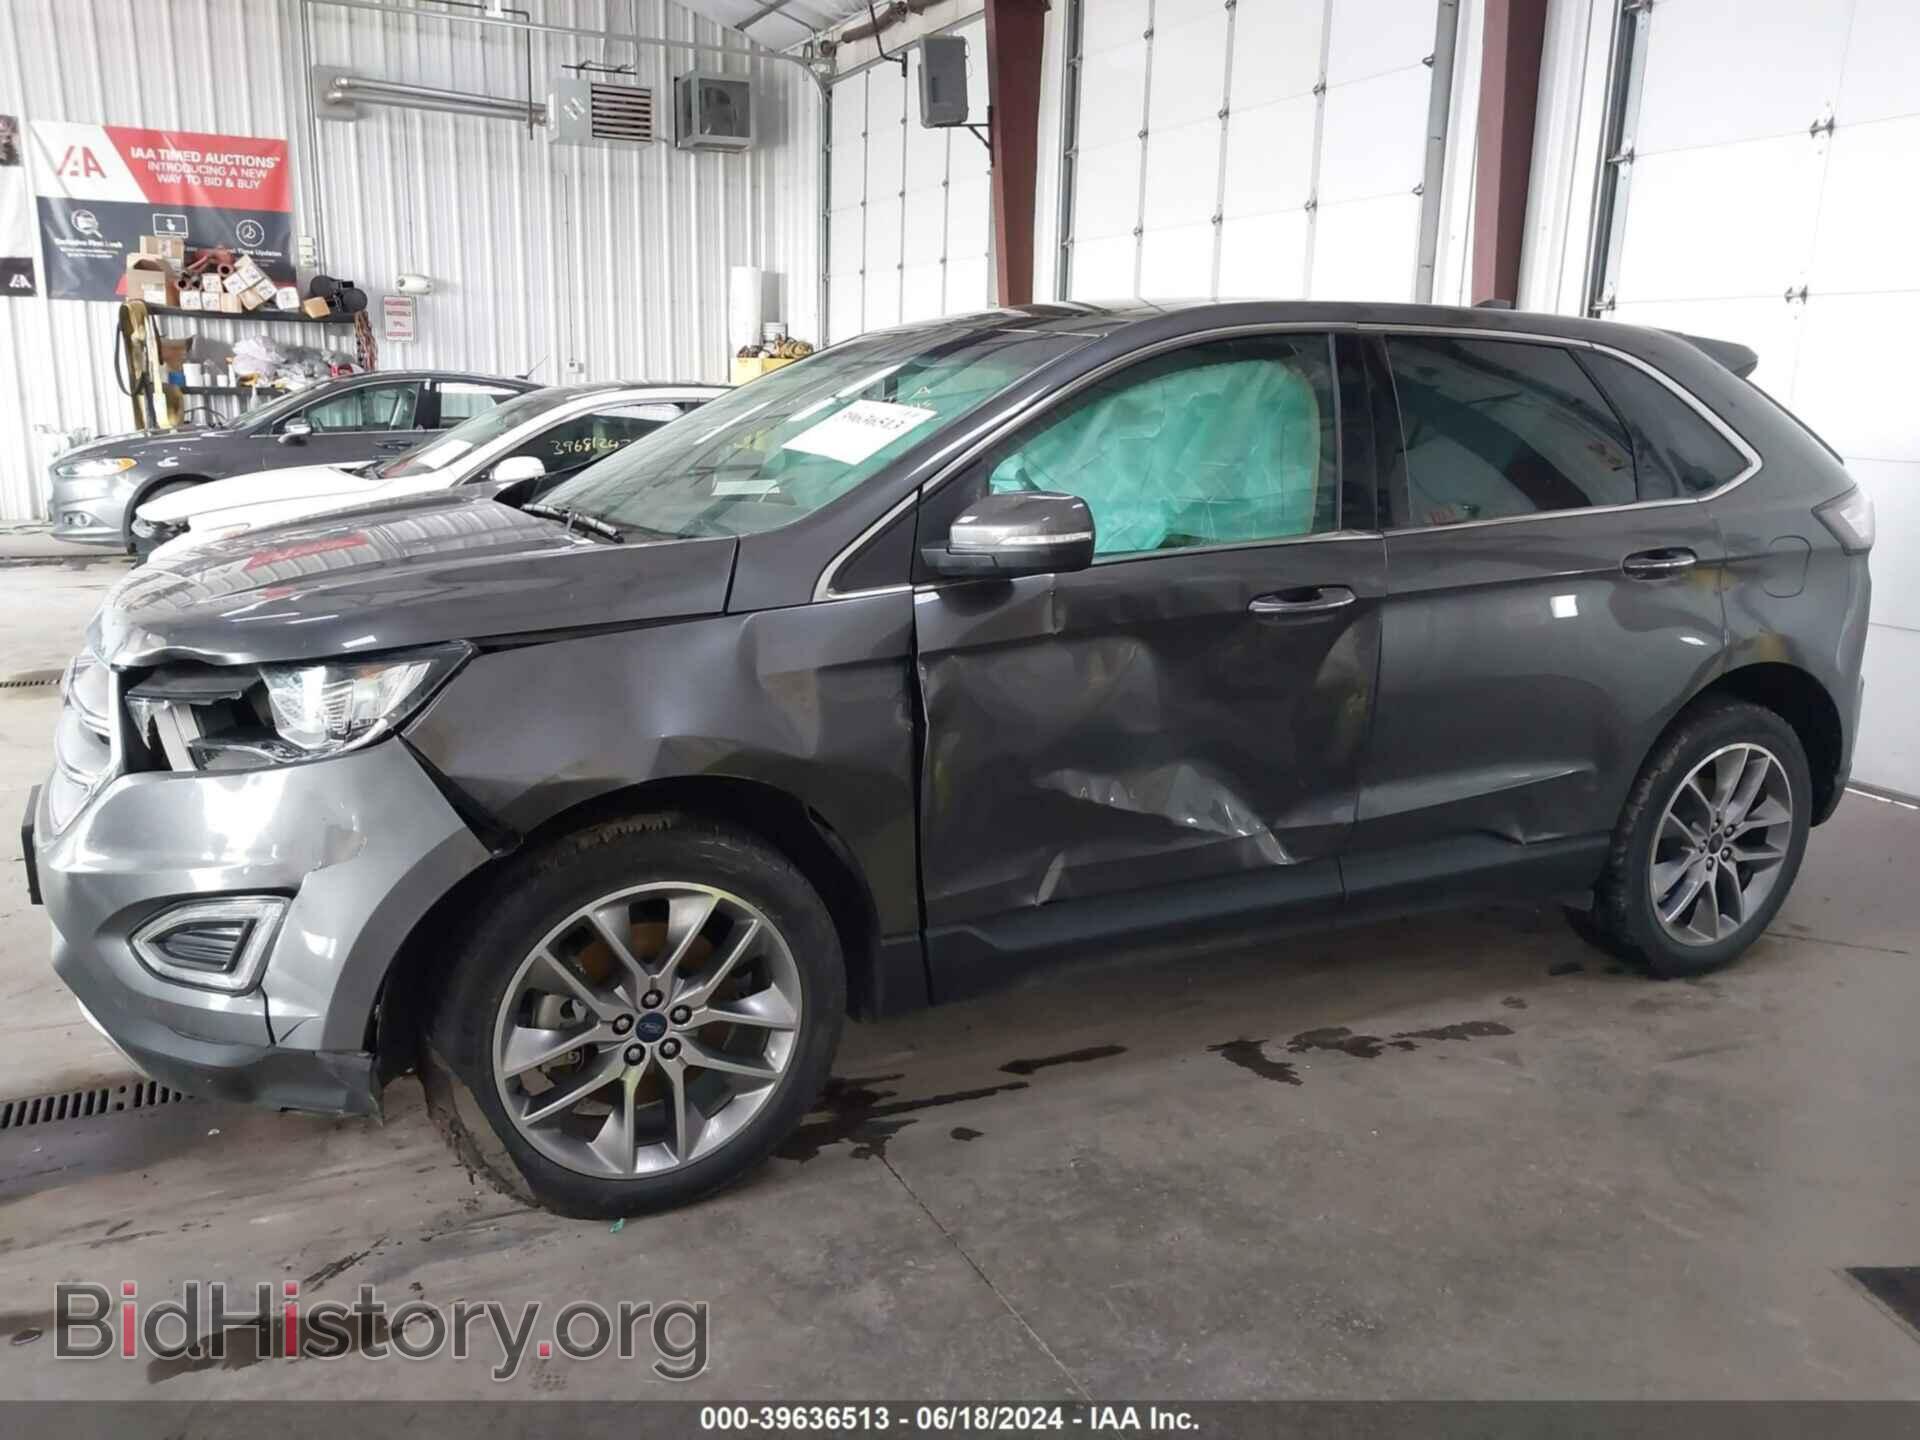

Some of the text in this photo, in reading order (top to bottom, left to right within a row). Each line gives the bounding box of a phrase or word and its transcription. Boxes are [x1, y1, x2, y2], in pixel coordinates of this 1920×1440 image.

[130, 147, 156, 160] IAA
[157, 149, 201, 163] TIMED
[147, 160, 268, 179] INTRODUCING A NEW
[156, 173, 261, 189] WAY TO BID & BUY
